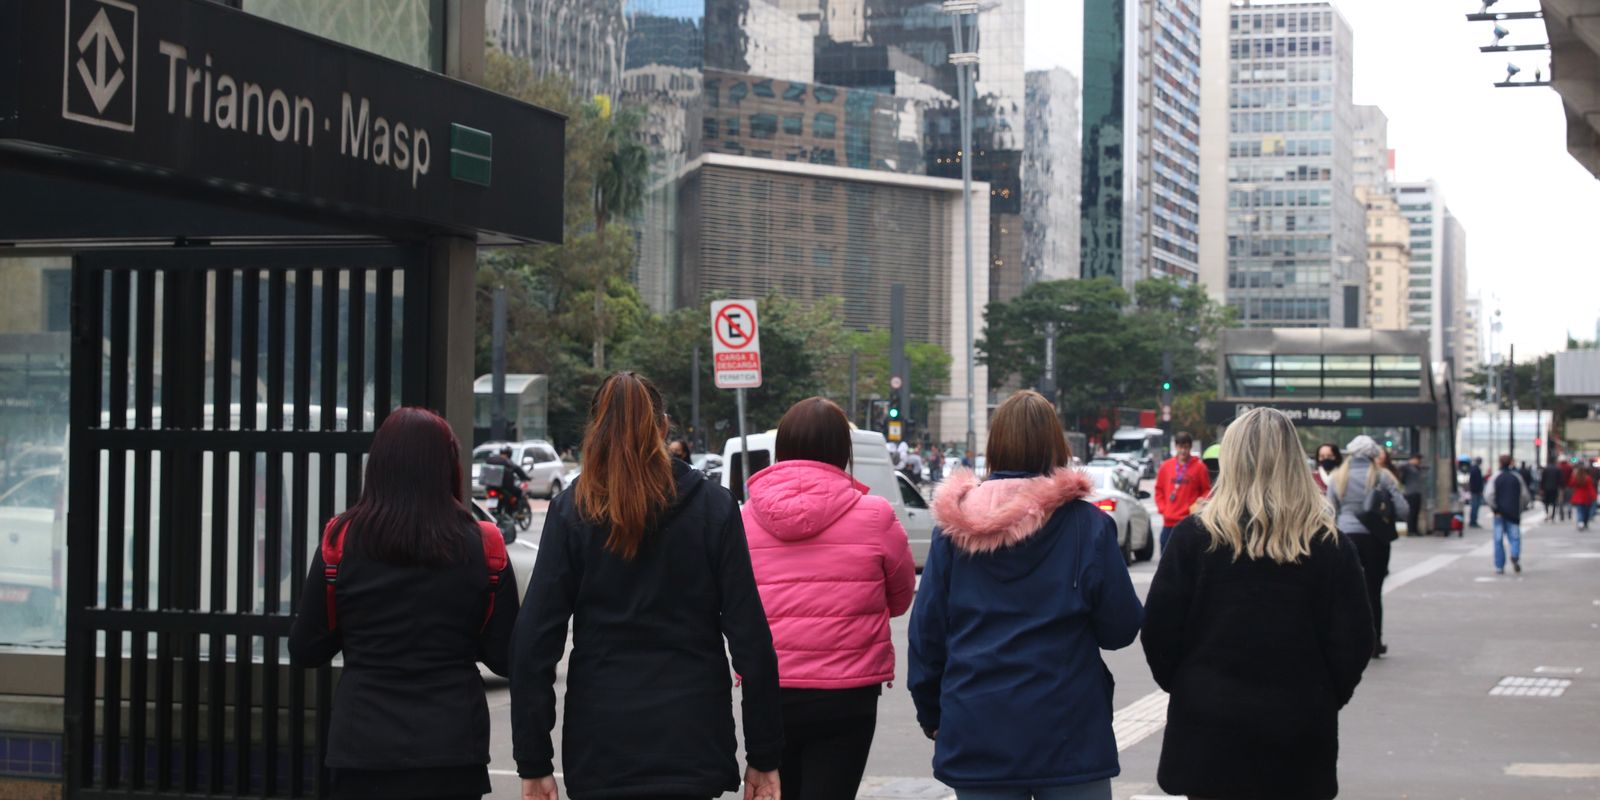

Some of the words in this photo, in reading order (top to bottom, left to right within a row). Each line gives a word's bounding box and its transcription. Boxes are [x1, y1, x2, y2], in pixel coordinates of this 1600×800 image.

[159, 40, 314, 147] Trianon
[341, 92, 431, 189] Masp
[719, 353, 745, 361] CARGA
[718, 361, 757, 369] DESCARGA
[1307, 407, 1342, 422] Masp
